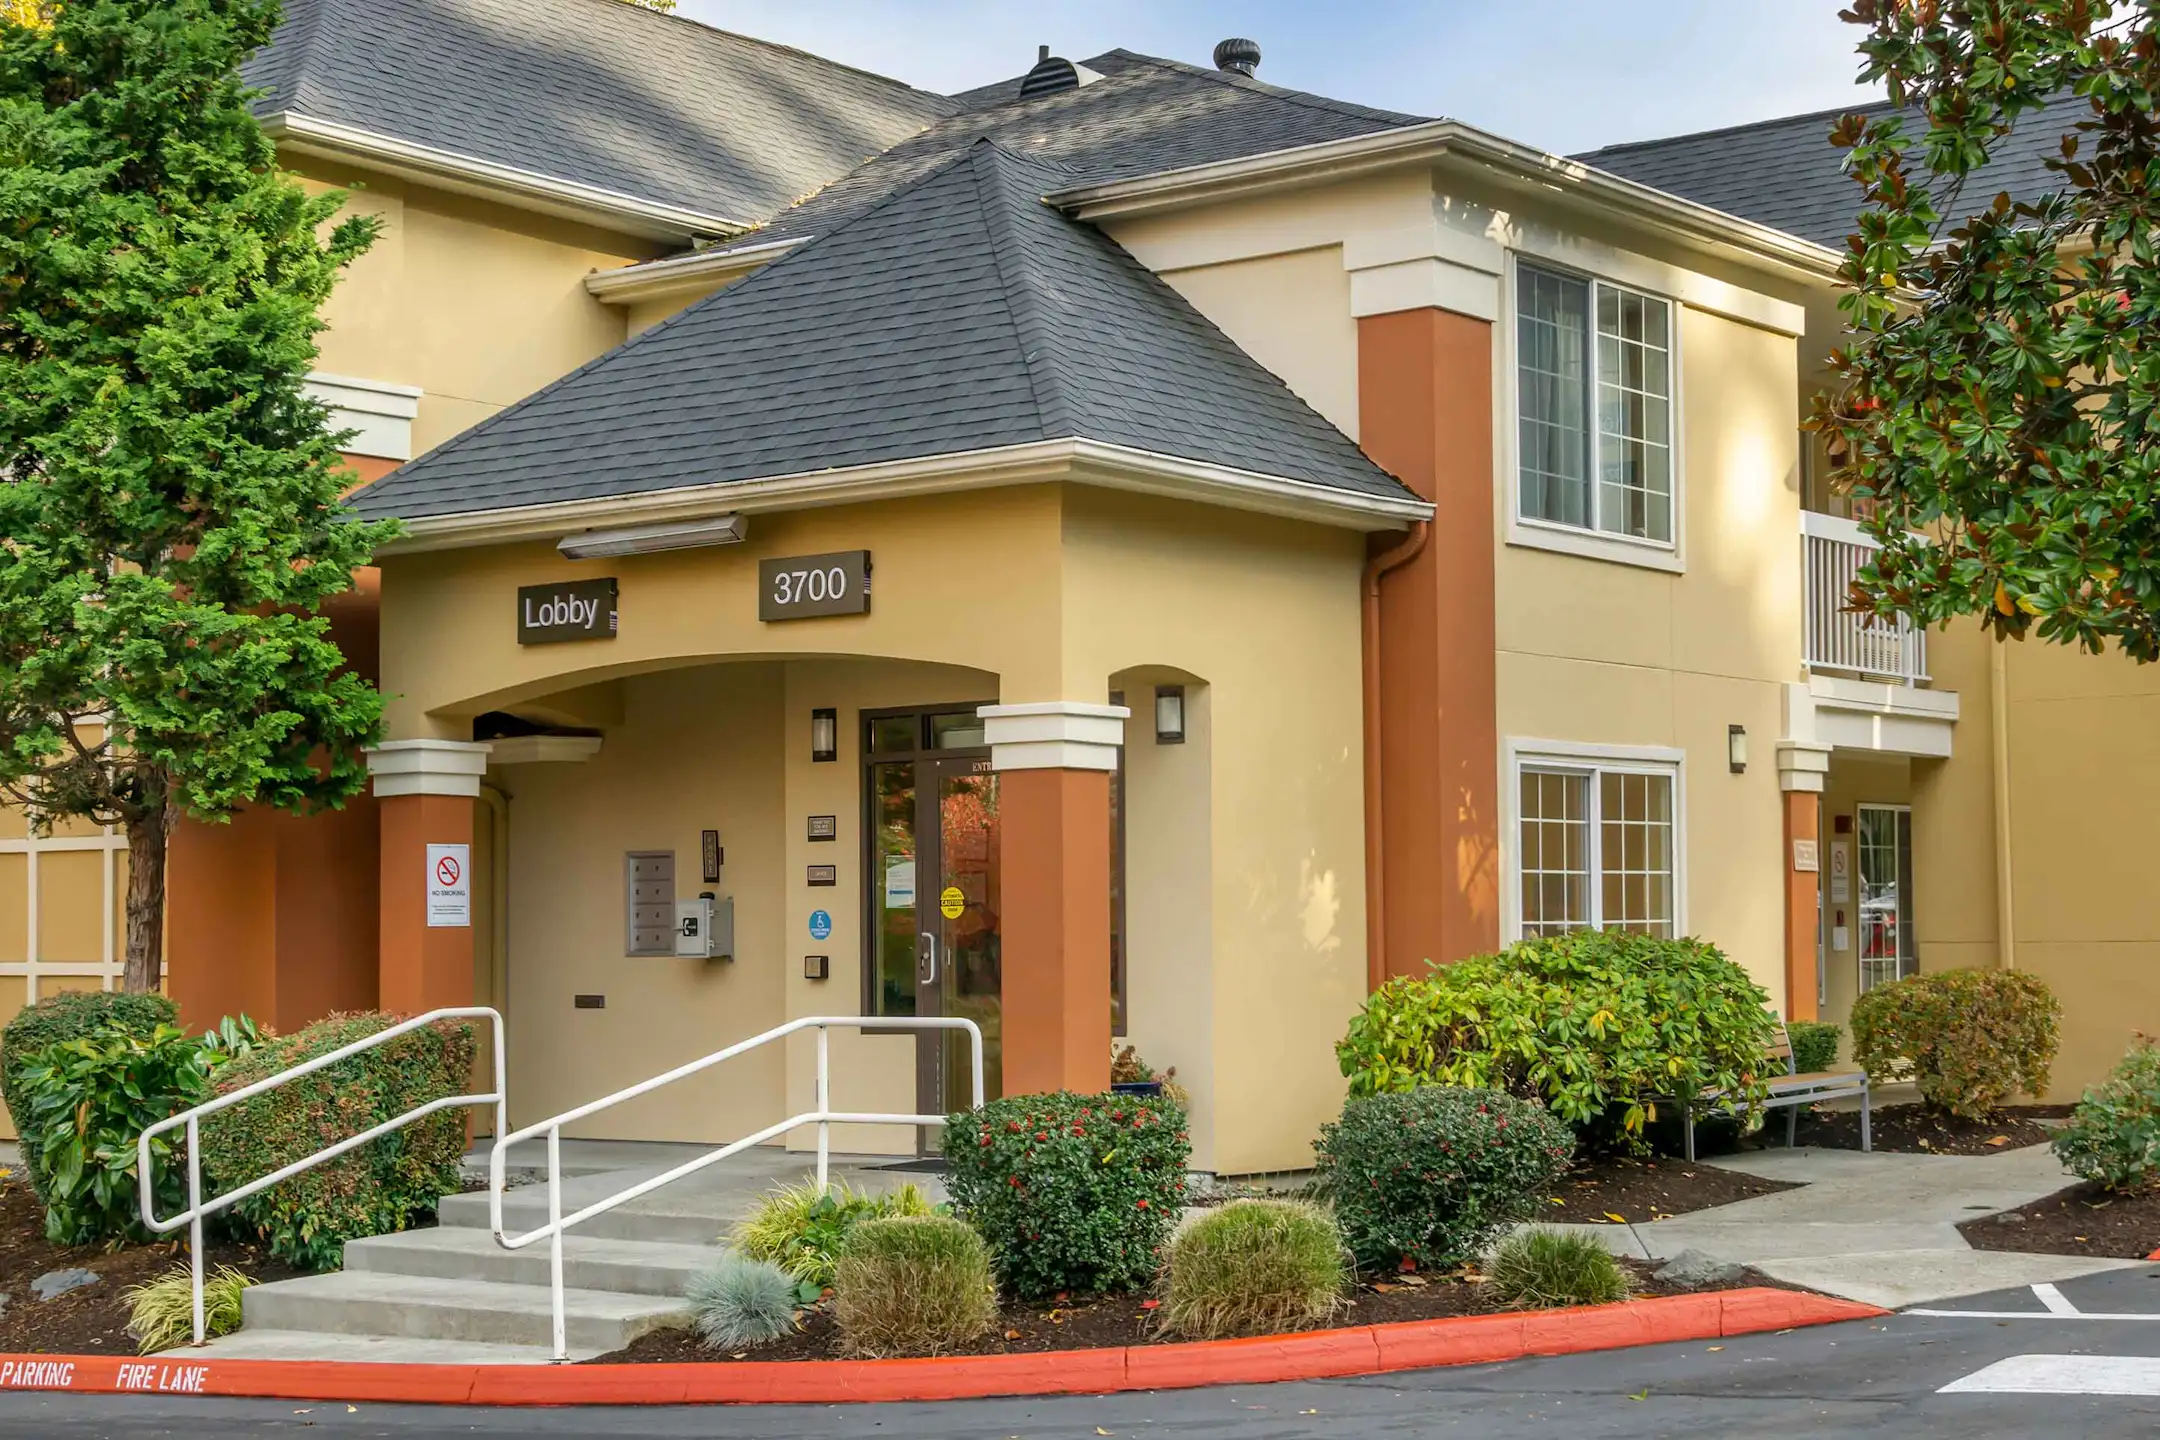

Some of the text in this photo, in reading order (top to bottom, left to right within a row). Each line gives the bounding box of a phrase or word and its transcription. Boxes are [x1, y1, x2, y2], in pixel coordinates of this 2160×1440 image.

[773, 567, 847, 605] 3700
[525, 594, 599, 630] Lobby
[0, 1361, 75, 1387] PARKING
[116, 1364, 209, 1392] FIRE LANE
